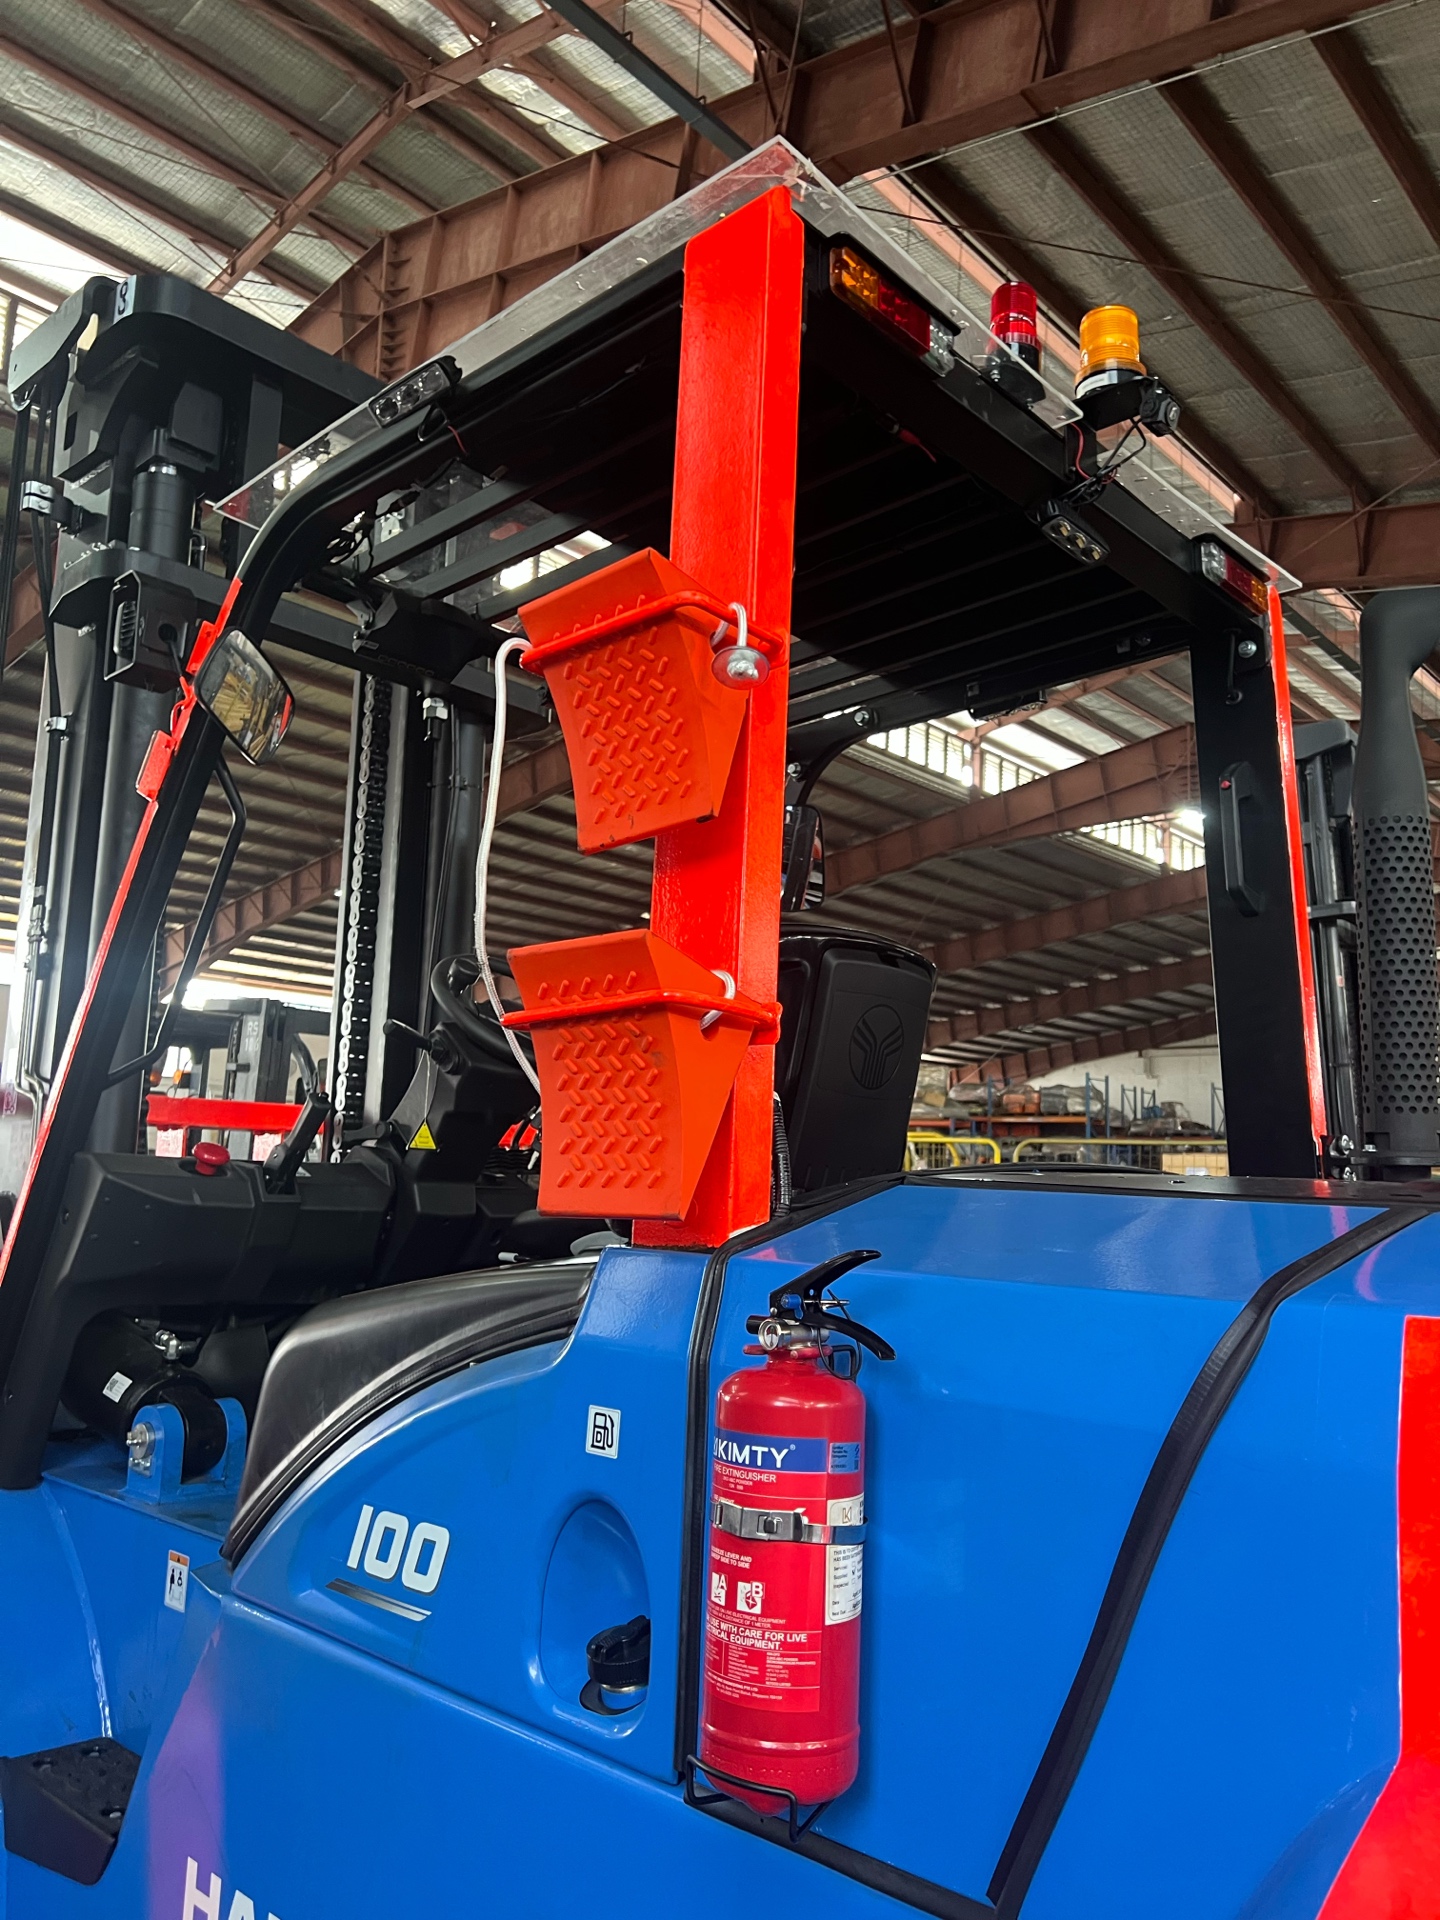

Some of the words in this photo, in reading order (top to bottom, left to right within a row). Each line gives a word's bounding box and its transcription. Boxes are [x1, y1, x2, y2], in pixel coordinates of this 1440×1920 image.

[722, 1466, 777, 1483] EXTINGUISHER
[346, 1504, 450, 1593] 100
[725, 1551, 739, 1560] LEVER
[740, 1555, 752, 1563] AND
[752, 1582, 764, 1598] B
[758, 1616, 786, 1624] EQUIPMENT
[720, 1621, 738, 1634] WITH
[738, 1628, 762, 1639] CARE
[764, 1632, 784, 1642] FOR
[786, 1634, 808, 1642] LIVE
[730, 1634, 782, 1650] EQUIPMENT.
